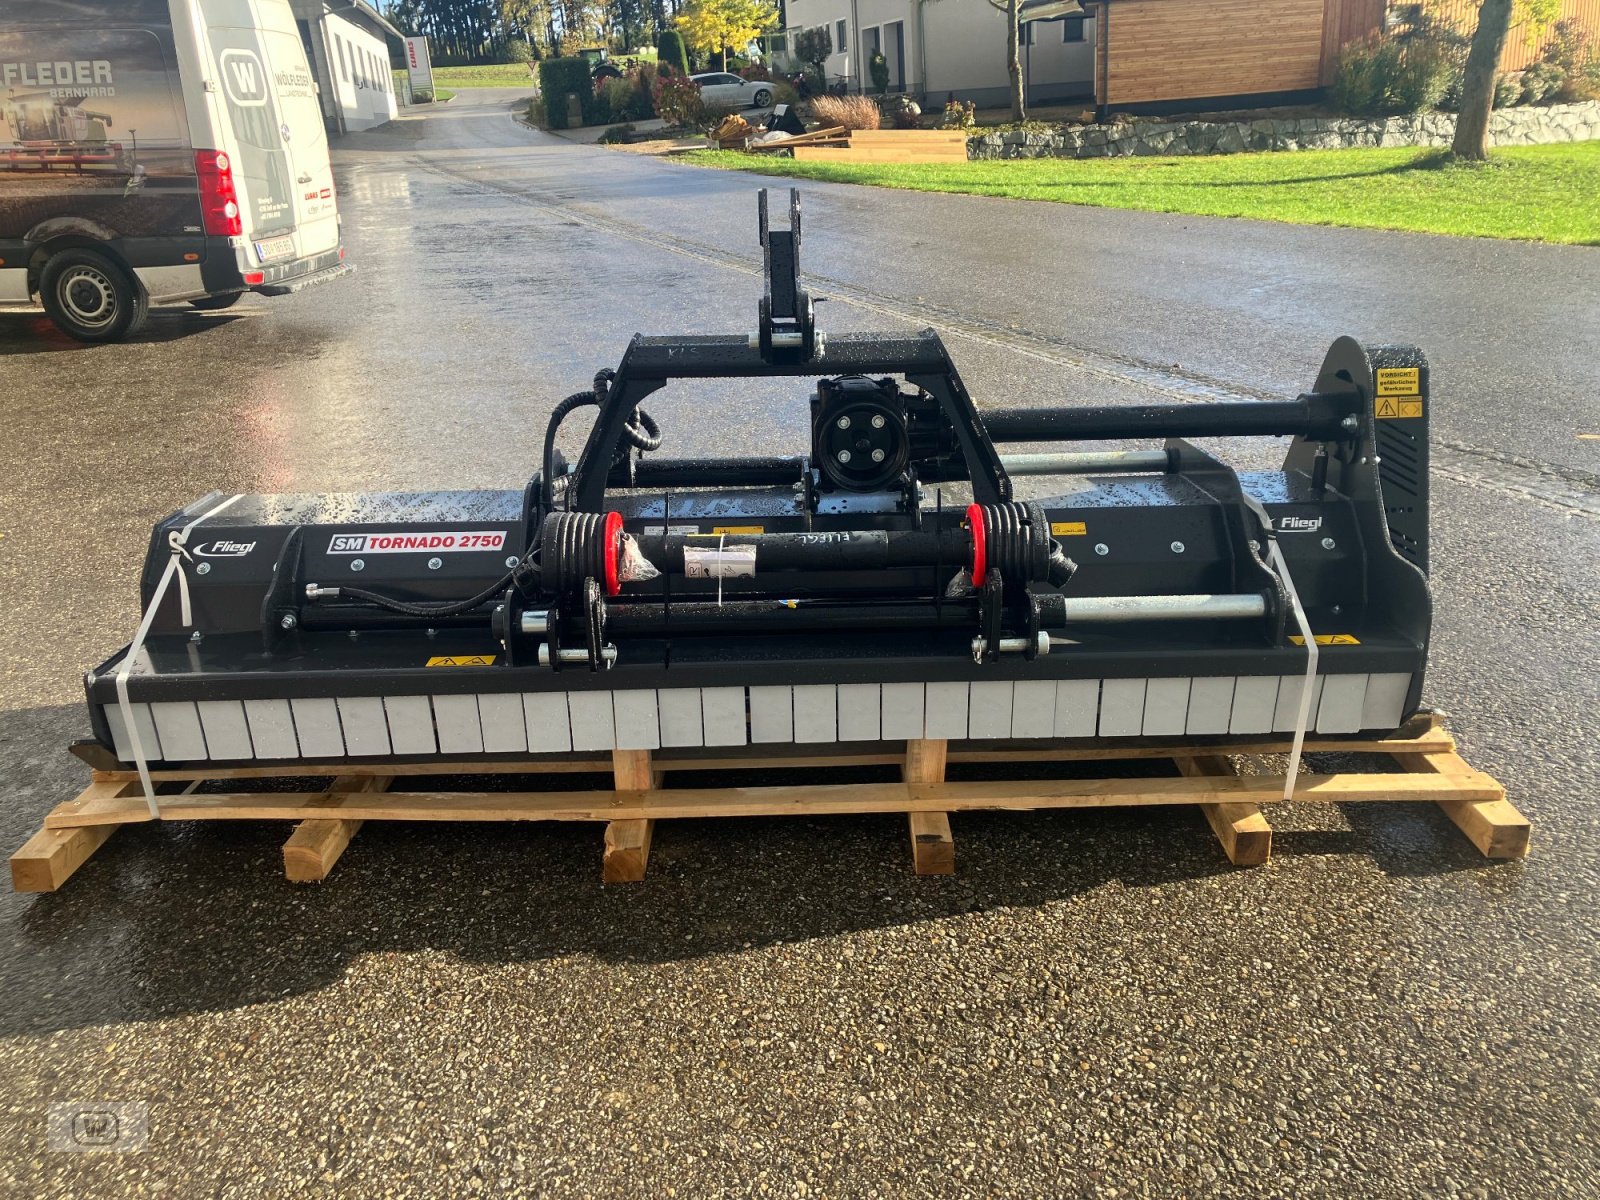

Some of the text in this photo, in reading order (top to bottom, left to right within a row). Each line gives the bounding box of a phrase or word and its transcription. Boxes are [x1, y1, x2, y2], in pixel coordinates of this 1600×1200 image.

[0, 60, 113, 86] FLEDER
[230, 62, 257, 93] W
[49, 87, 116, 98] BERNHARD
[1281, 516, 1323, 530] Fliegl
[211, 541, 256, 555] Fliegl
[334, 535, 503, 550] SM TORNADO 2750
